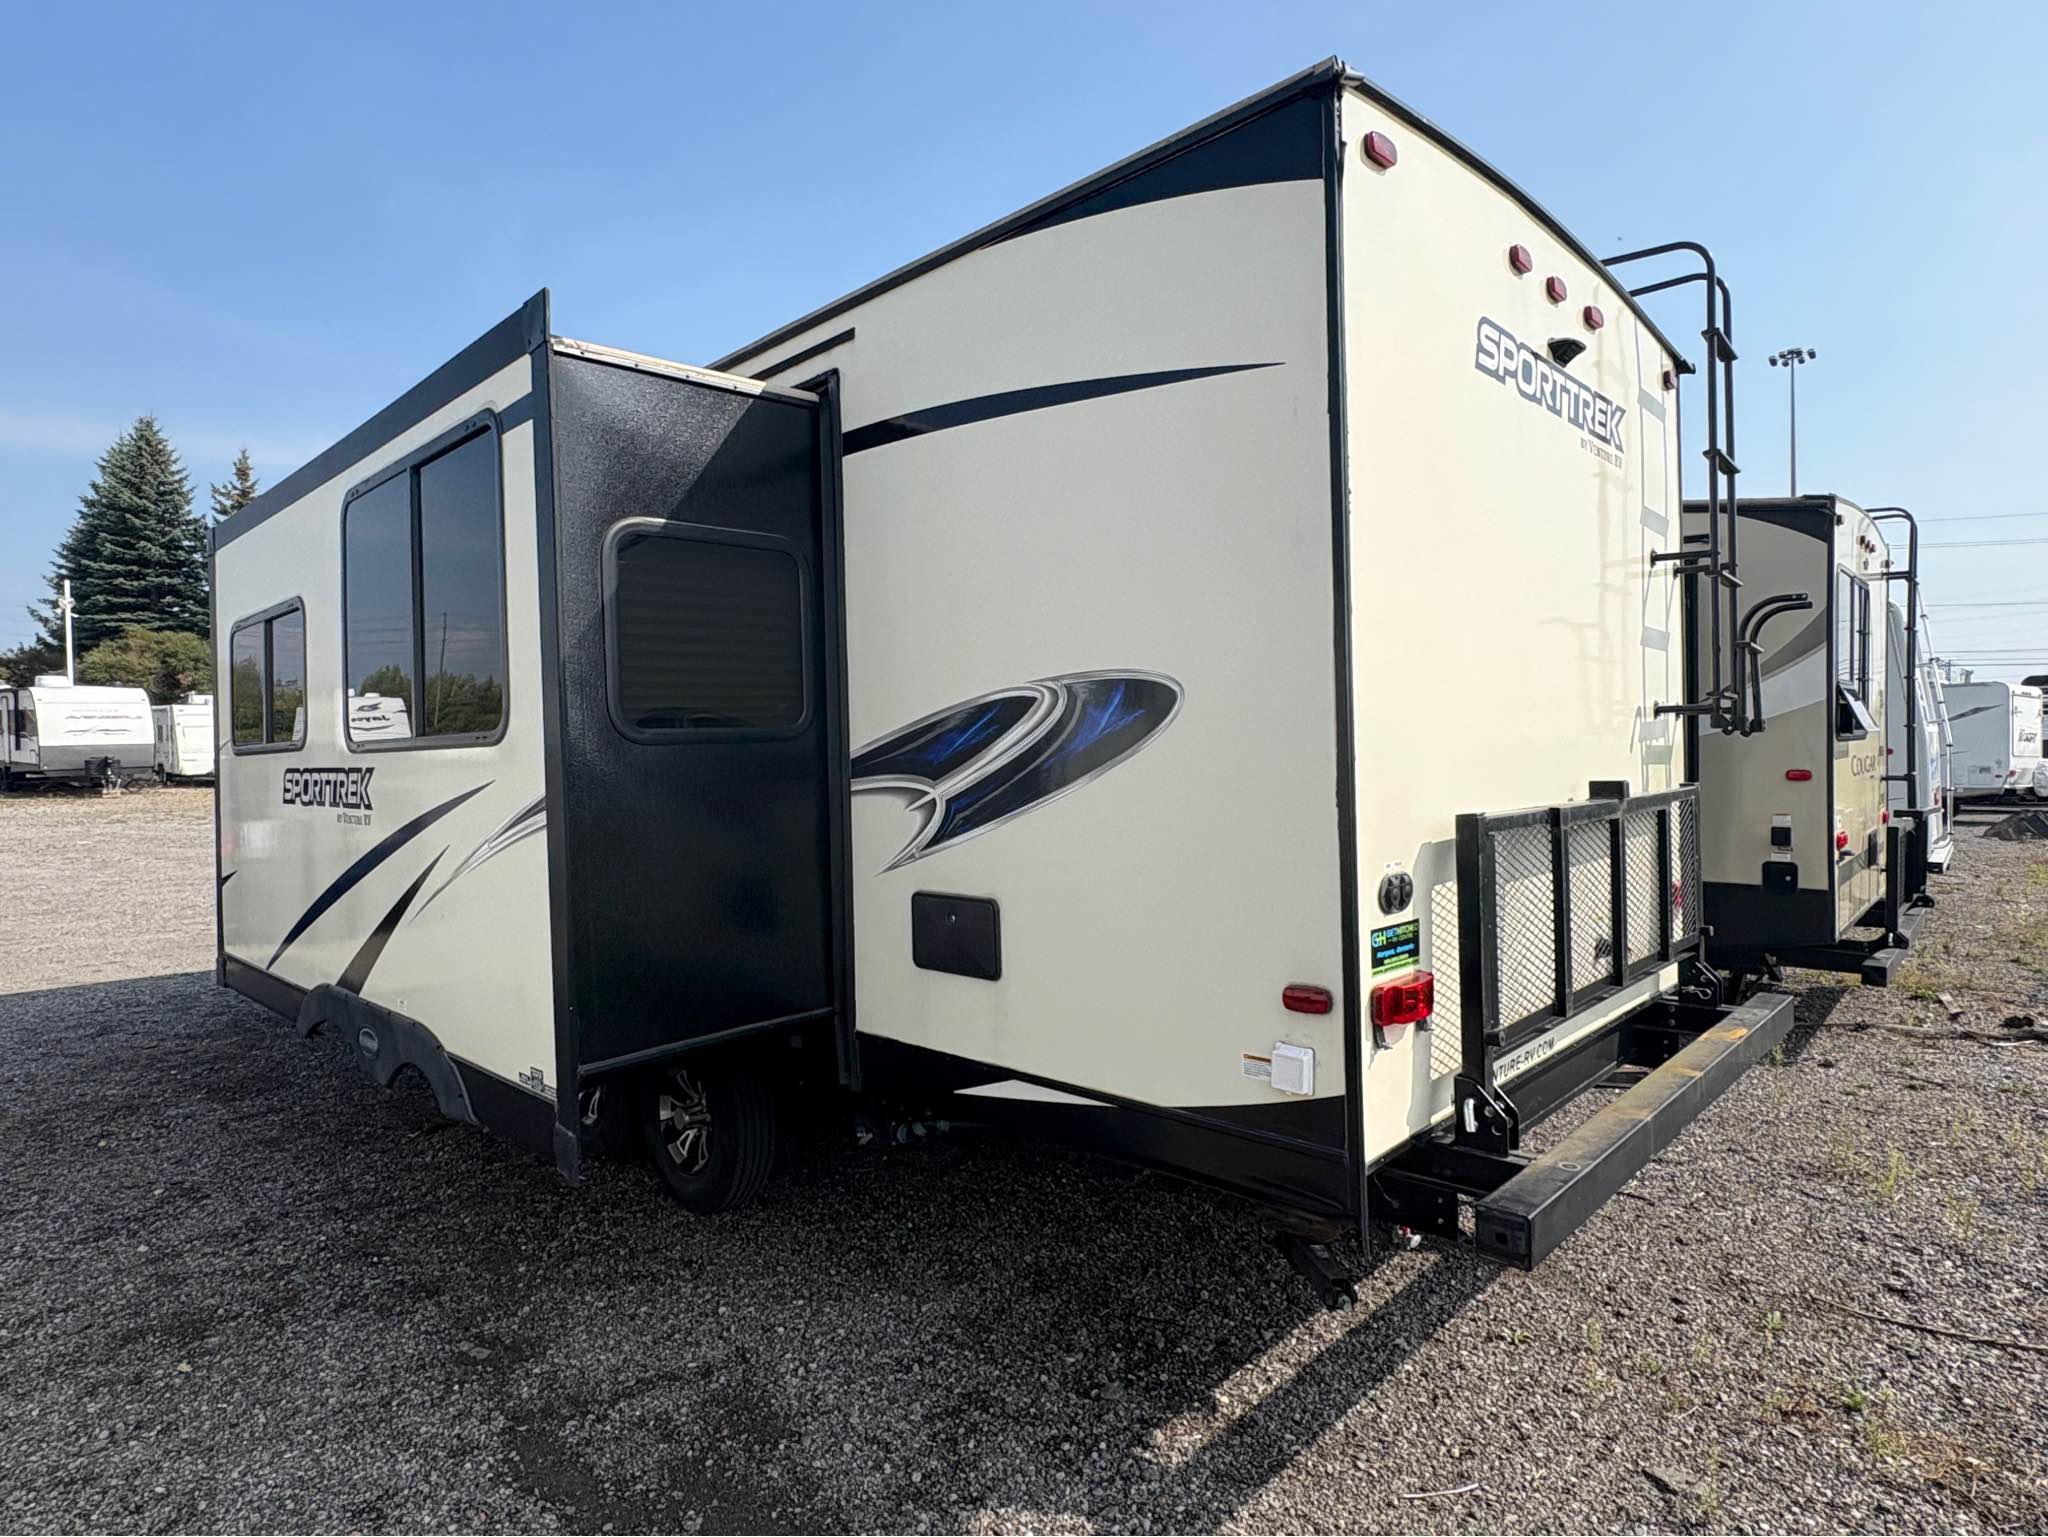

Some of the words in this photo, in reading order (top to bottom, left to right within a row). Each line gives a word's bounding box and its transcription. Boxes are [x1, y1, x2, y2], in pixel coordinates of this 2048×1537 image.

[1475, 316, 1626, 454] SPORTTREK
[283, 767, 375, 810] SPORTTREK
[1371, 930, 1387, 948] GH
